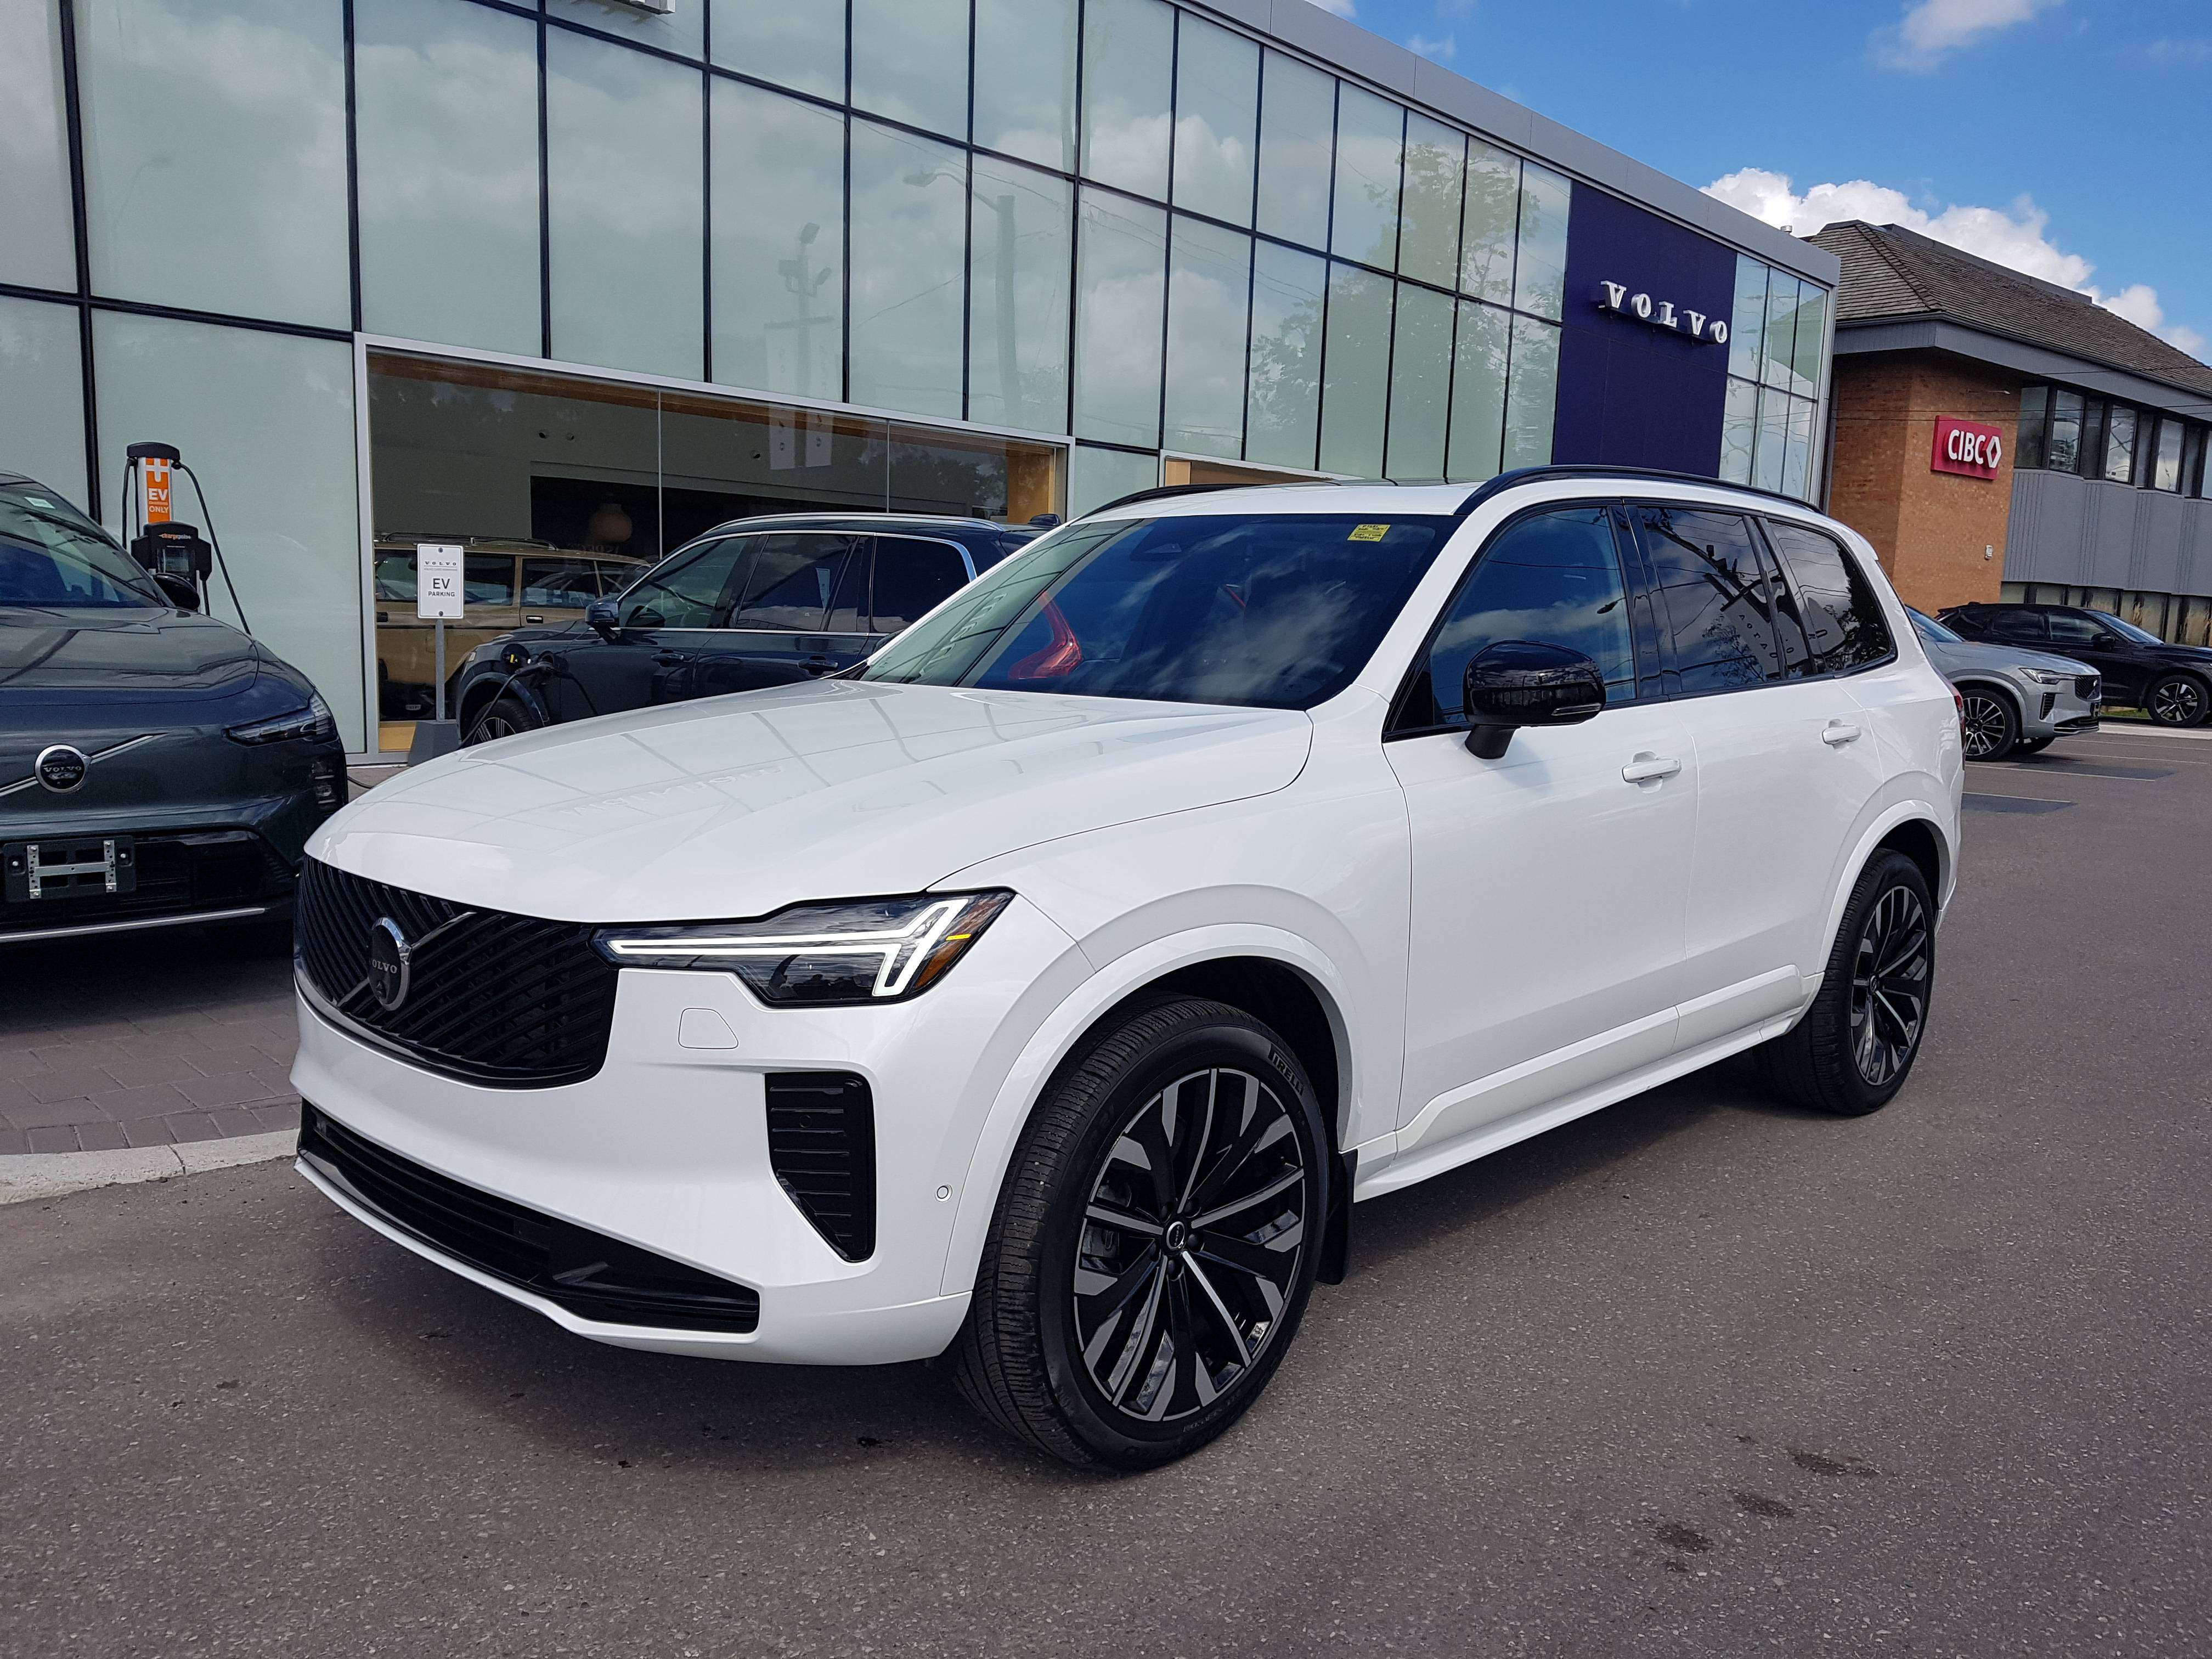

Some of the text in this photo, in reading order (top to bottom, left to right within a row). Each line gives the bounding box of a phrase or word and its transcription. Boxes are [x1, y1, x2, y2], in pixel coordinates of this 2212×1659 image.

[1600, 280, 1728, 344] VOLVO
[1948, 429, 1986, 465] CIBC
[148, 488, 168, 501] EV
[433, 578, 450, 589] EV
